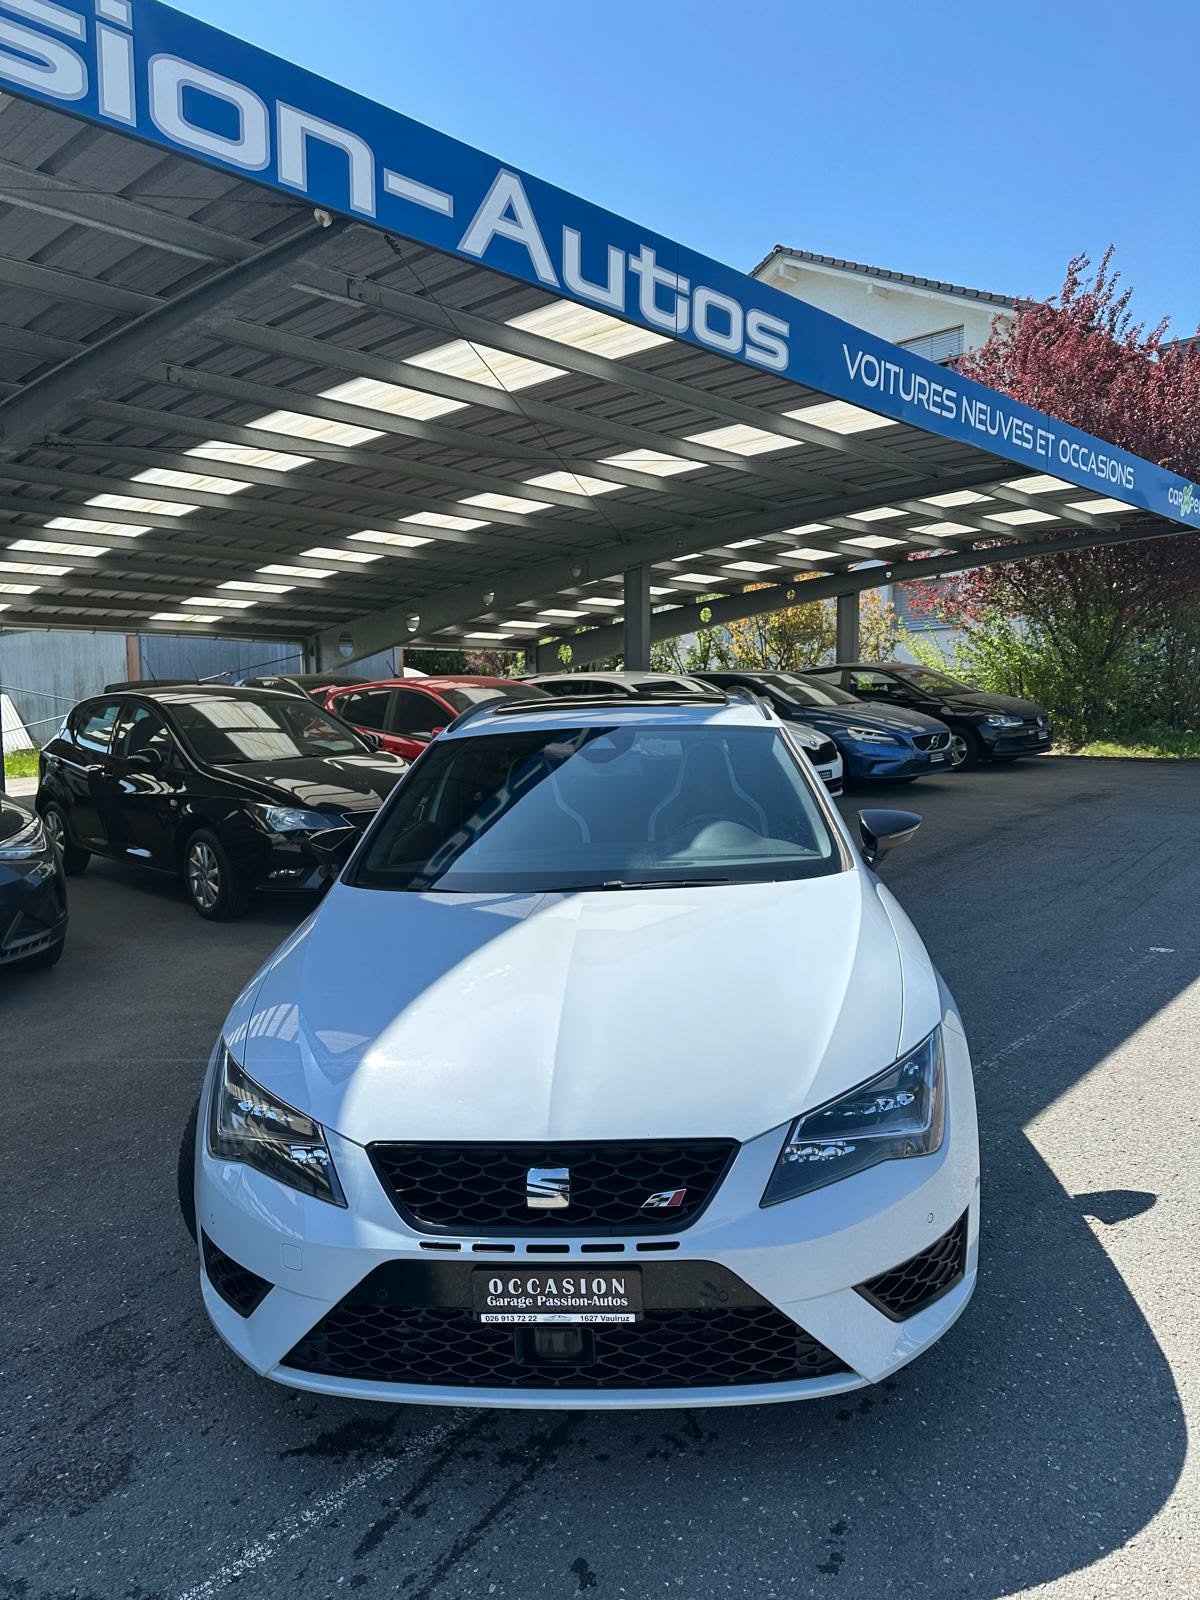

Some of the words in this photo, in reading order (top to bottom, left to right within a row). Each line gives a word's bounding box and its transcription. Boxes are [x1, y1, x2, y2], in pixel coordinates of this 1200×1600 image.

[843, 343, 957, 419] VOITURES
[962, 395, 1034, 449] NEUVES
[1036, 428, 1056, 457] ET
[1059, 439, 1135, 490] OCCASIONS
[488, 1278, 625, 1295] OCCASION
[487, 1295, 533, 1308] Garage
[537, 1295, 628, 1307] Passion-Autos
